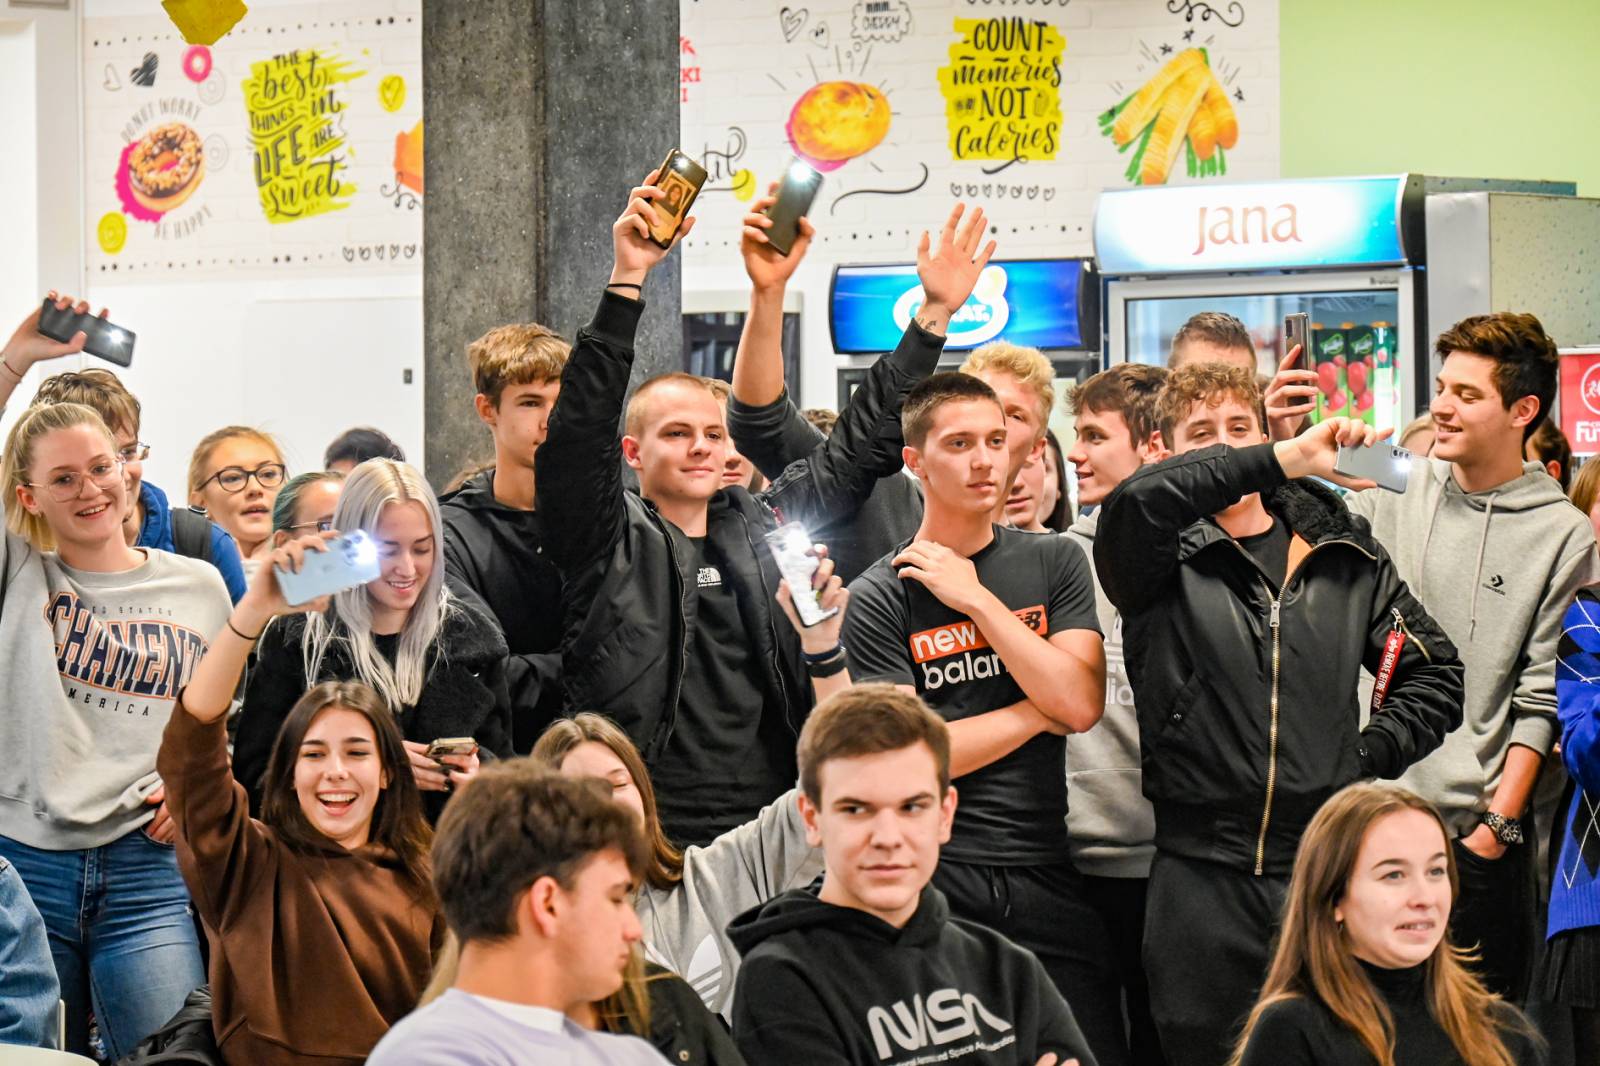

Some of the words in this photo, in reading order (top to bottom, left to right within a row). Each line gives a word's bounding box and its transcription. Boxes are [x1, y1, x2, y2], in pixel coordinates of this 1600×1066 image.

[974, 15, 1047, 52] COUNT
[263, 51, 319, 102] best
[273, 50, 300, 69] THE
[953, 55, 1061, 88] memories
[160, 98, 201, 121] WORRY
[249, 103, 295, 131] THINGS
[311, 89, 341, 117] in
[979, 86, 1031, 121] NOT
[254, 124, 306, 187] LIFE
[309, 123, 336, 151] ARE
[173, 204, 213, 240] HAPPY
[913, 624, 976, 659] new
[867, 988, 1012, 1060] NASA
